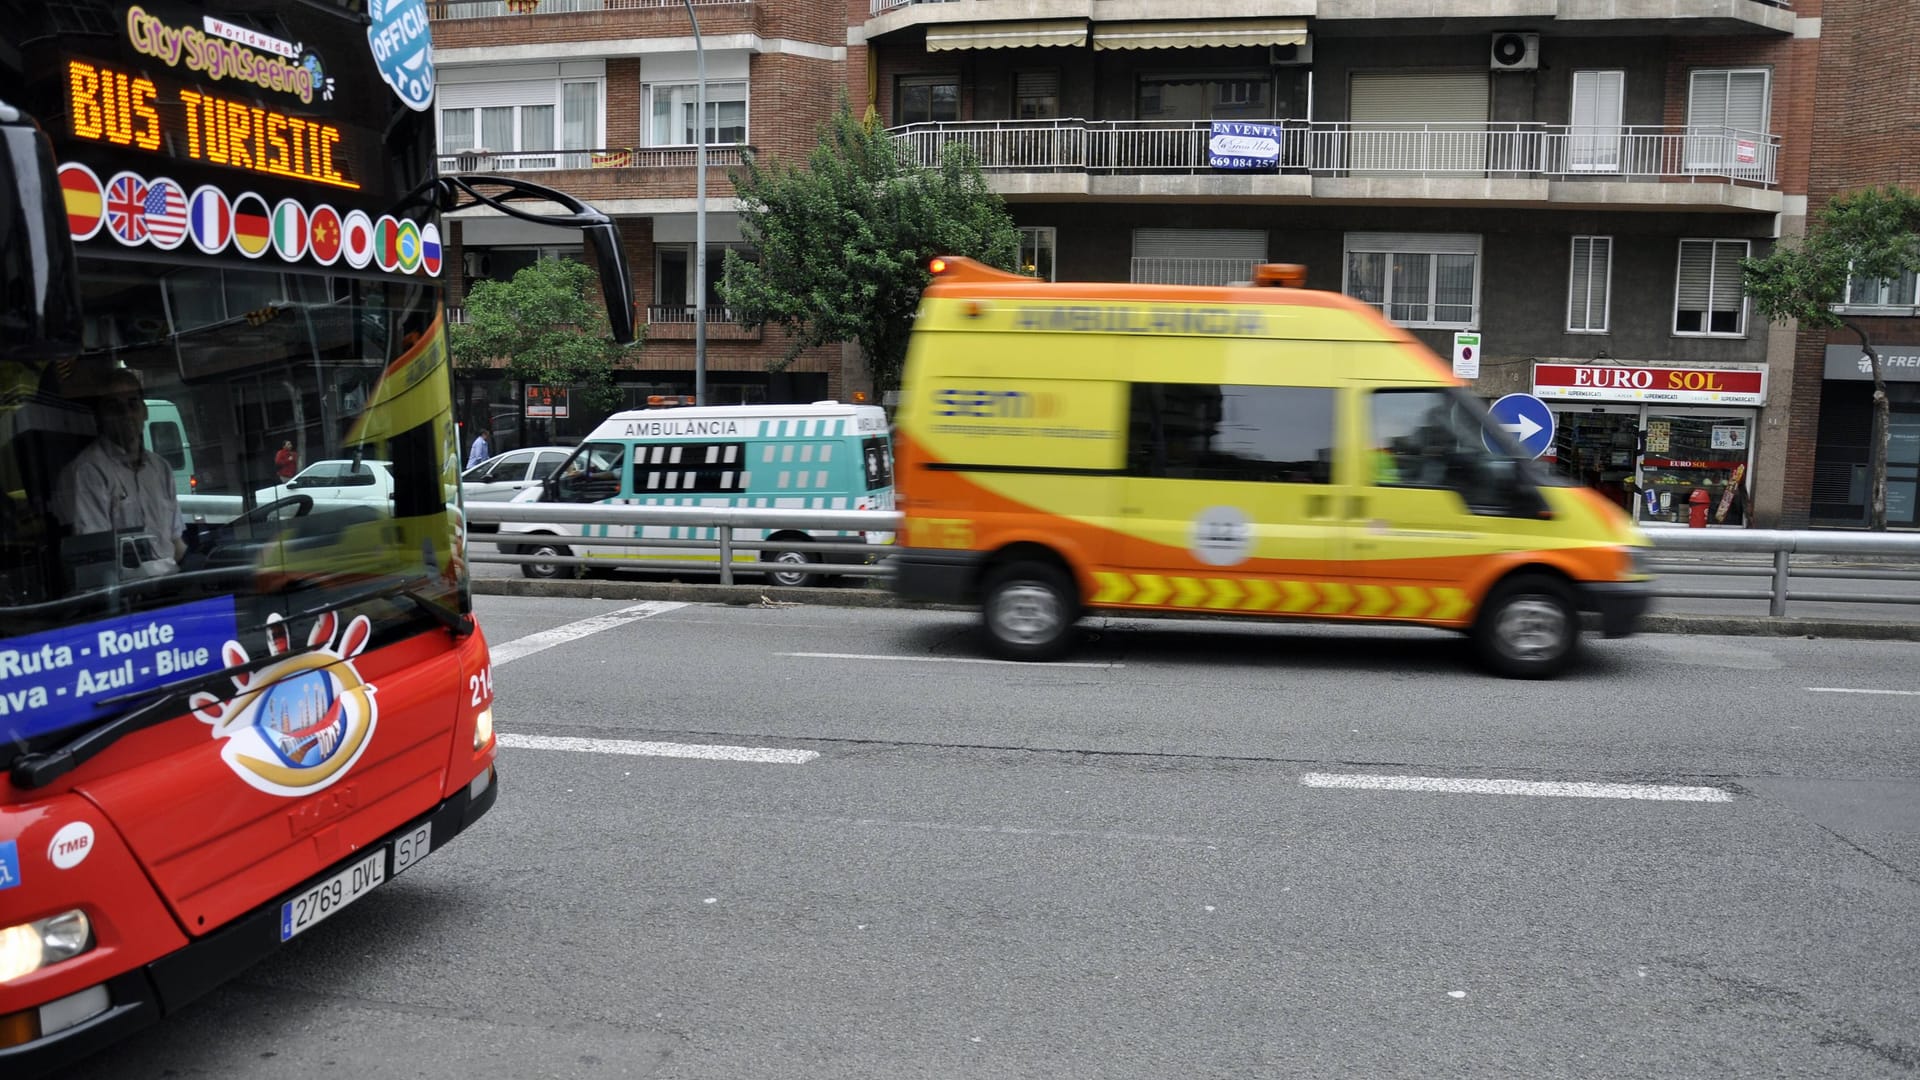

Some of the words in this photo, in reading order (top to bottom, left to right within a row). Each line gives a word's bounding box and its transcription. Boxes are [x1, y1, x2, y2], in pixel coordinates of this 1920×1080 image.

[127, 5, 182, 66] City
[182, 26, 312, 104] Sightseeing
[212, 21, 291, 55] Worldwide
[69, 61, 160, 150] BUS
[180, 90, 342, 182] TURISTIC
[1213, 122, 1231, 133] EN
[1234, 125, 1278, 137] VENTA
[1210, 157, 1230, 167] 669
[1232, 158, 1252, 168] 084
[1255, 159, 1275, 169] 257
[1573, 367, 1653, 389] EURO
[1668, 371, 1723, 391] SOL
[0, 644, 73, 680] Ruta
[98, 621, 175, 658] Route
[75, 659, 134, 698] Azul
[156, 646, 209, 676] Blue
[58, 835, 89, 856] TMB
[296, 879, 343, 929] 2769
[352, 857, 381, 895] DVL
